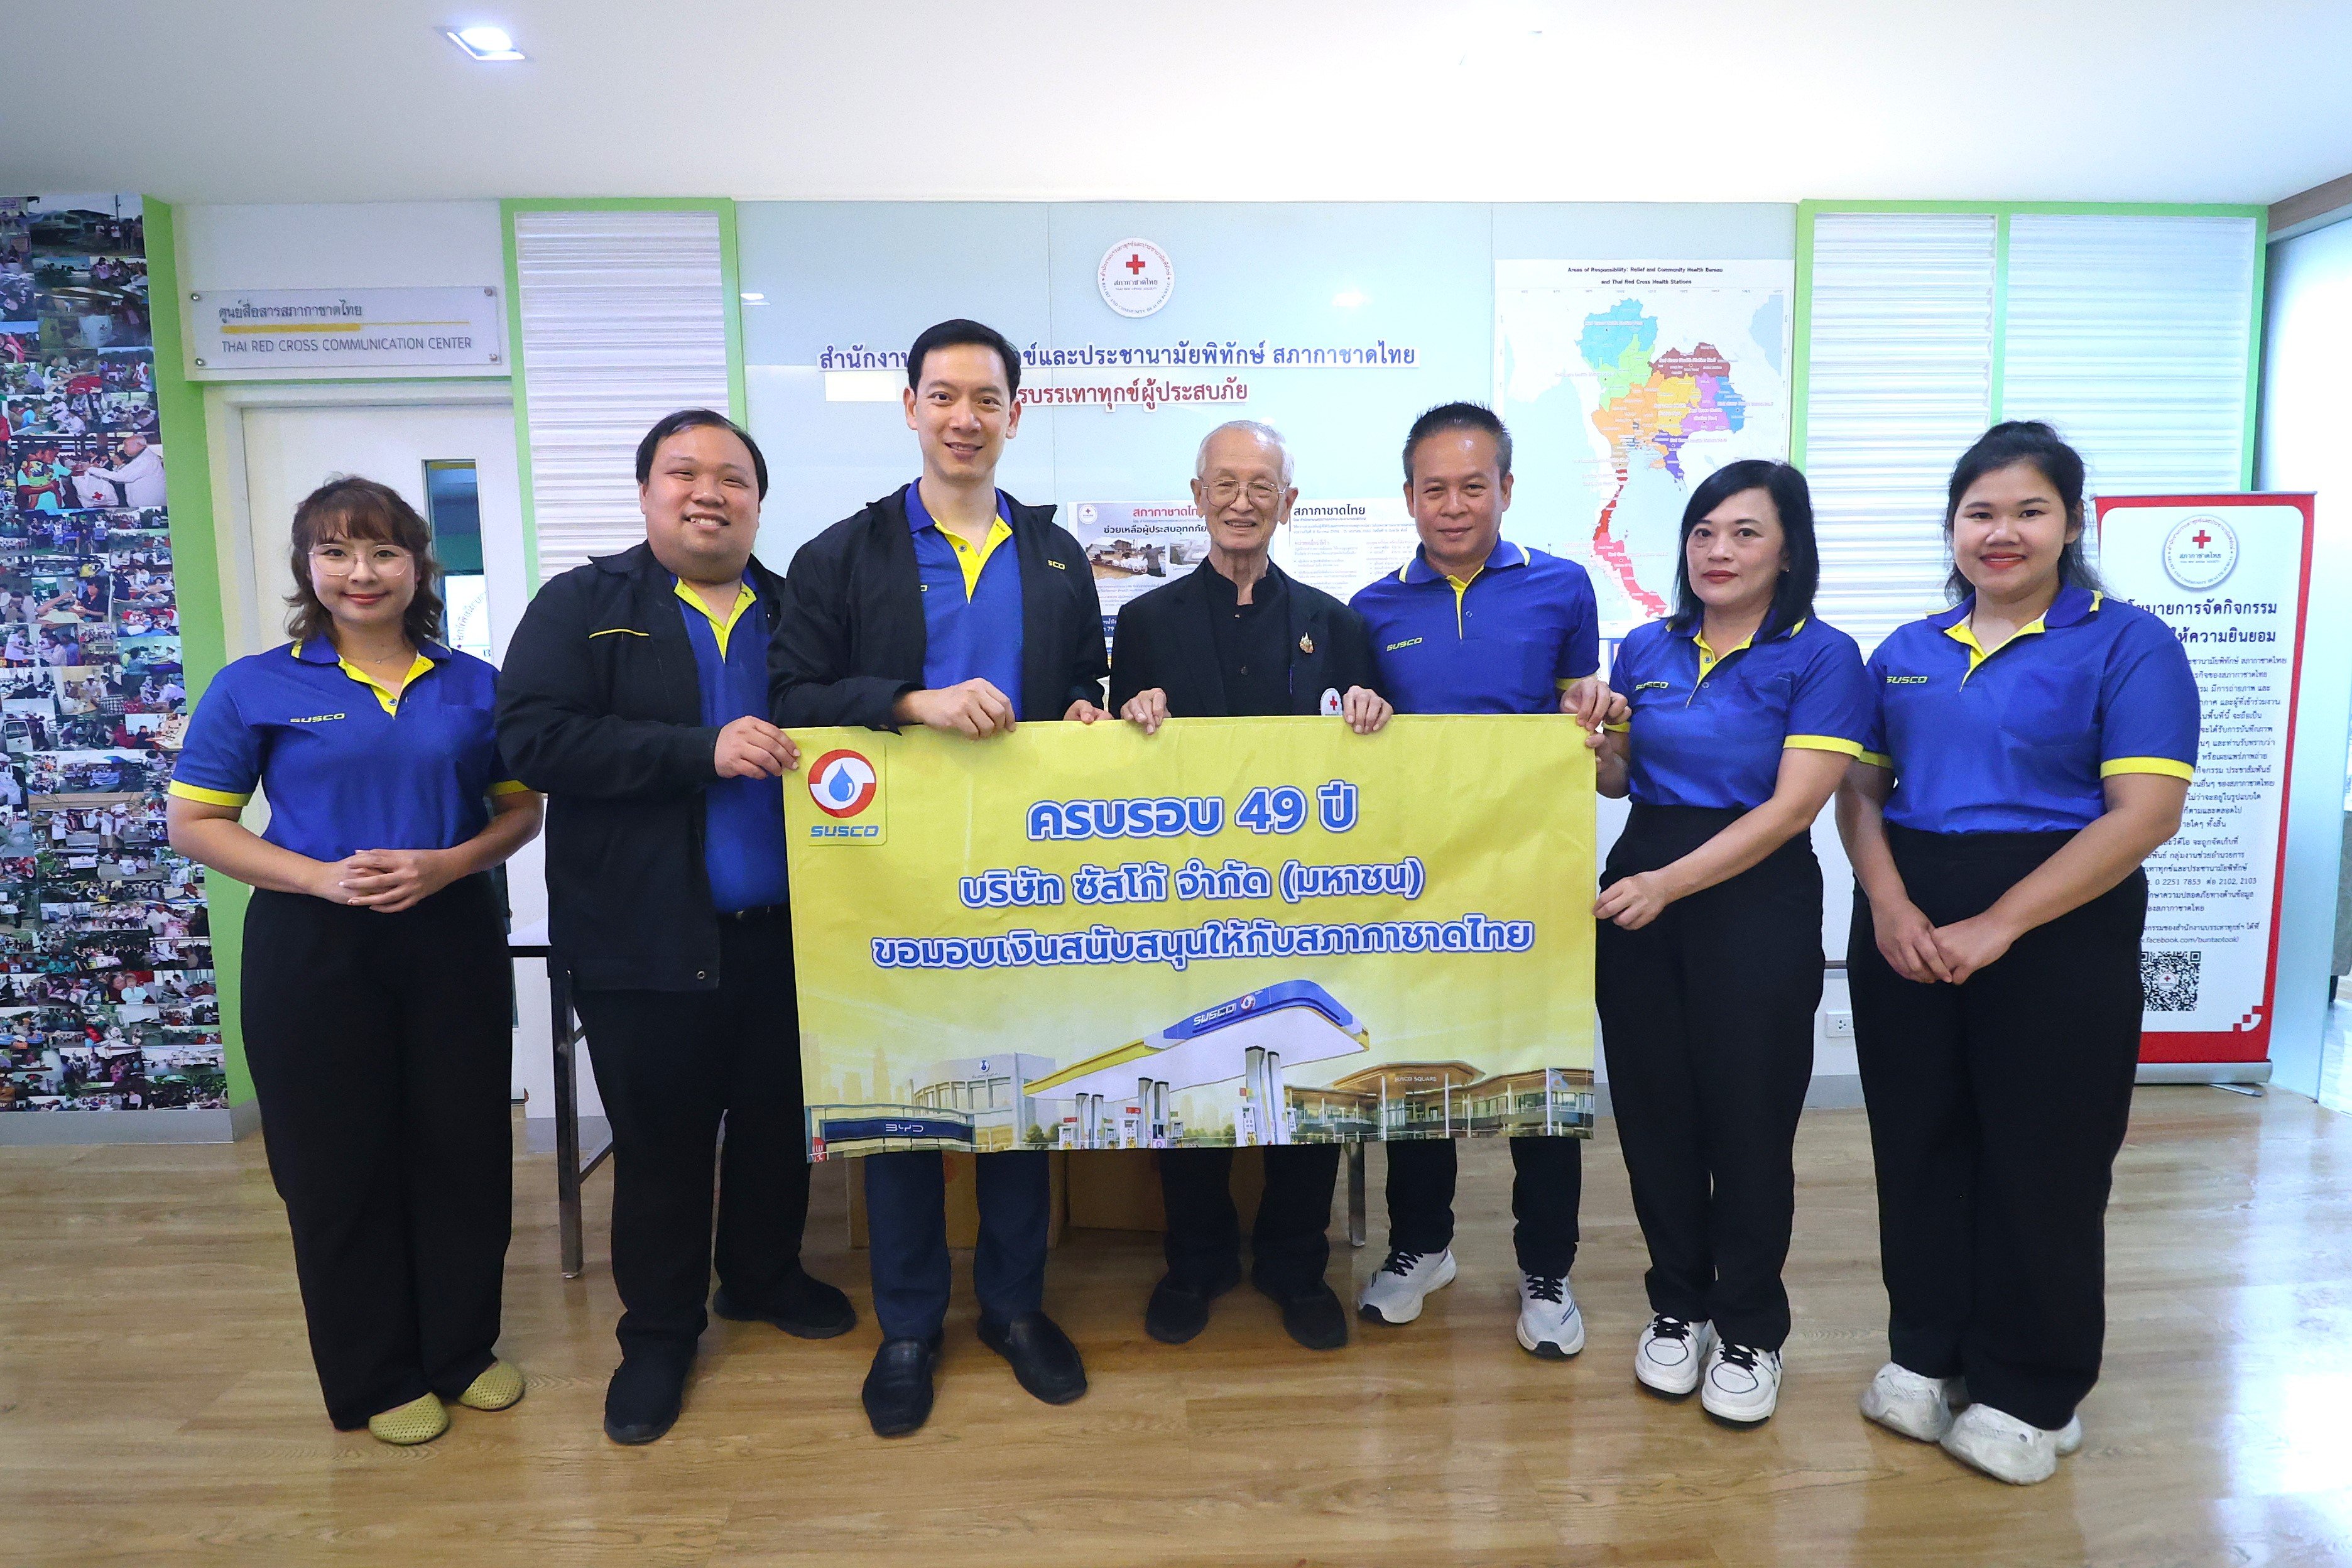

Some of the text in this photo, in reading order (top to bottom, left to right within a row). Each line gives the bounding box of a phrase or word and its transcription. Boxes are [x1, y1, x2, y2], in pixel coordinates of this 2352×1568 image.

[219, 300, 362, 323] ศูนย์สื่อสารสภากาชาดไทย
[222, 337, 472, 352] THAI RED CROSS COMMUNICATION CENTER
[1273, 341, 1415, 364] สภากาชาดไทย
[1293, 504, 1366, 516] สภากาชาดไทย
[1104, 524, 1207, 535] ช่วยเหลือผู้ประสบอุทกภัย
[1386, 636, 1423, 651] SUSCO
[1886, 675, 1928, 684] SUSCO
[290, 712, 346, 723] SUSCO
[1028, 780, 1357, 839] ครบรอบ 49 ปี
[810, 825, 879, 837] SUSCO
[961, 860, 1424, 906] บริษัท ซัสโก้ จำกัด (มหาชน)
[873, 913, 1534, 971] ขอมอบเงินสนับสนุนให้กับสภากาชาดไทย
[1193, 1003, 1237, 1027] SUSCO
[885, 1123, 924, 1133] BYD
